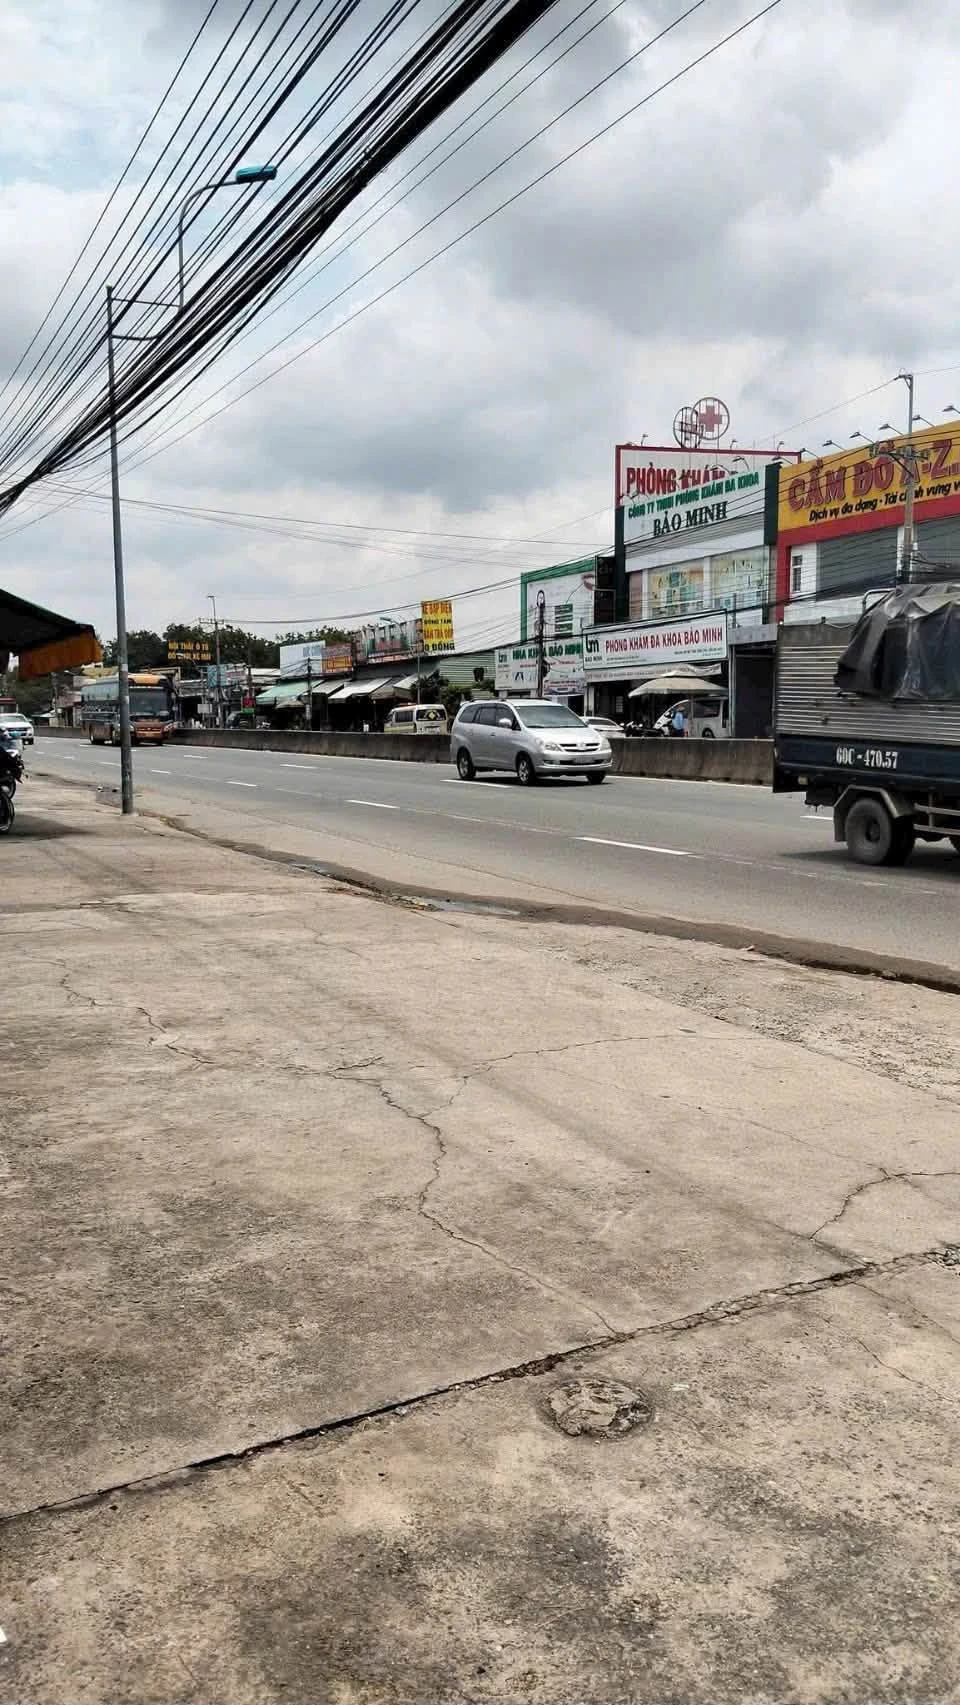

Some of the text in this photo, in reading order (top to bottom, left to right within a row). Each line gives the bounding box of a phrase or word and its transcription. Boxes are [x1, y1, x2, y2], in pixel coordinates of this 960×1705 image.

[626, 462, 677, 496] PHÒNG
[737, 471, 759, 489] KHOA
[653, 500, 728, 536] BẢO MINH
[809, 508, 828, 522] Dịch
[829, 506, 840, 519] vụ
[841, 502, 853, 514] đa
[855, 498, 878, 513] dạng
[884, 491, 898, 504] Tài
[662, 631, 682, 648] KHOA
[684, 626, 700, 646] BẢO
[702, 626, 723, 644] MINH
